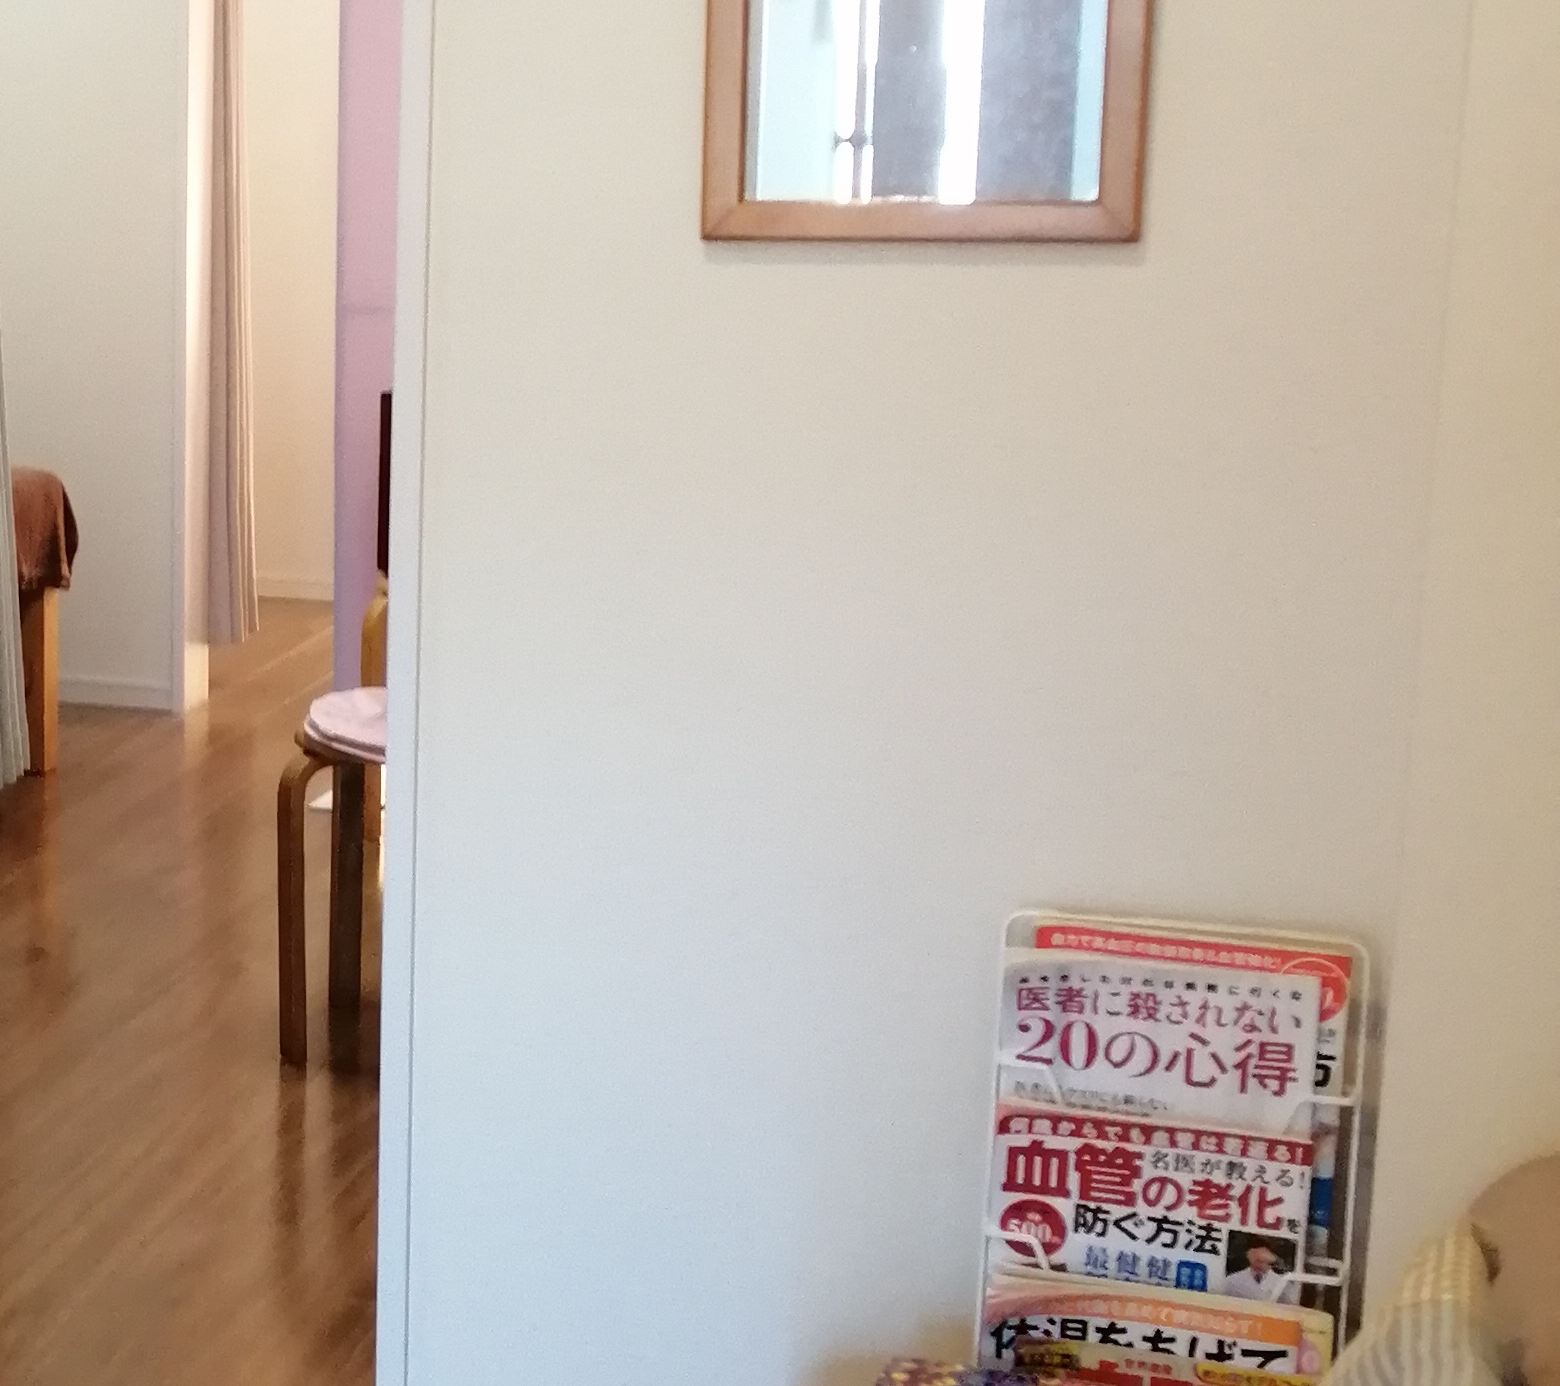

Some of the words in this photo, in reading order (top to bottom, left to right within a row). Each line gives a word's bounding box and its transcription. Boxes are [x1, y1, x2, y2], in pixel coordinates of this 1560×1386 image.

[1015, 985, 1302, 1034] 医者に殺されない
[1014, 1015, 1298, 1098] 20の心得
[1151, 1150, 1306, 1190] 名医が教える!
[1073, 1202, 1223, 1257] 防ぐ方法
